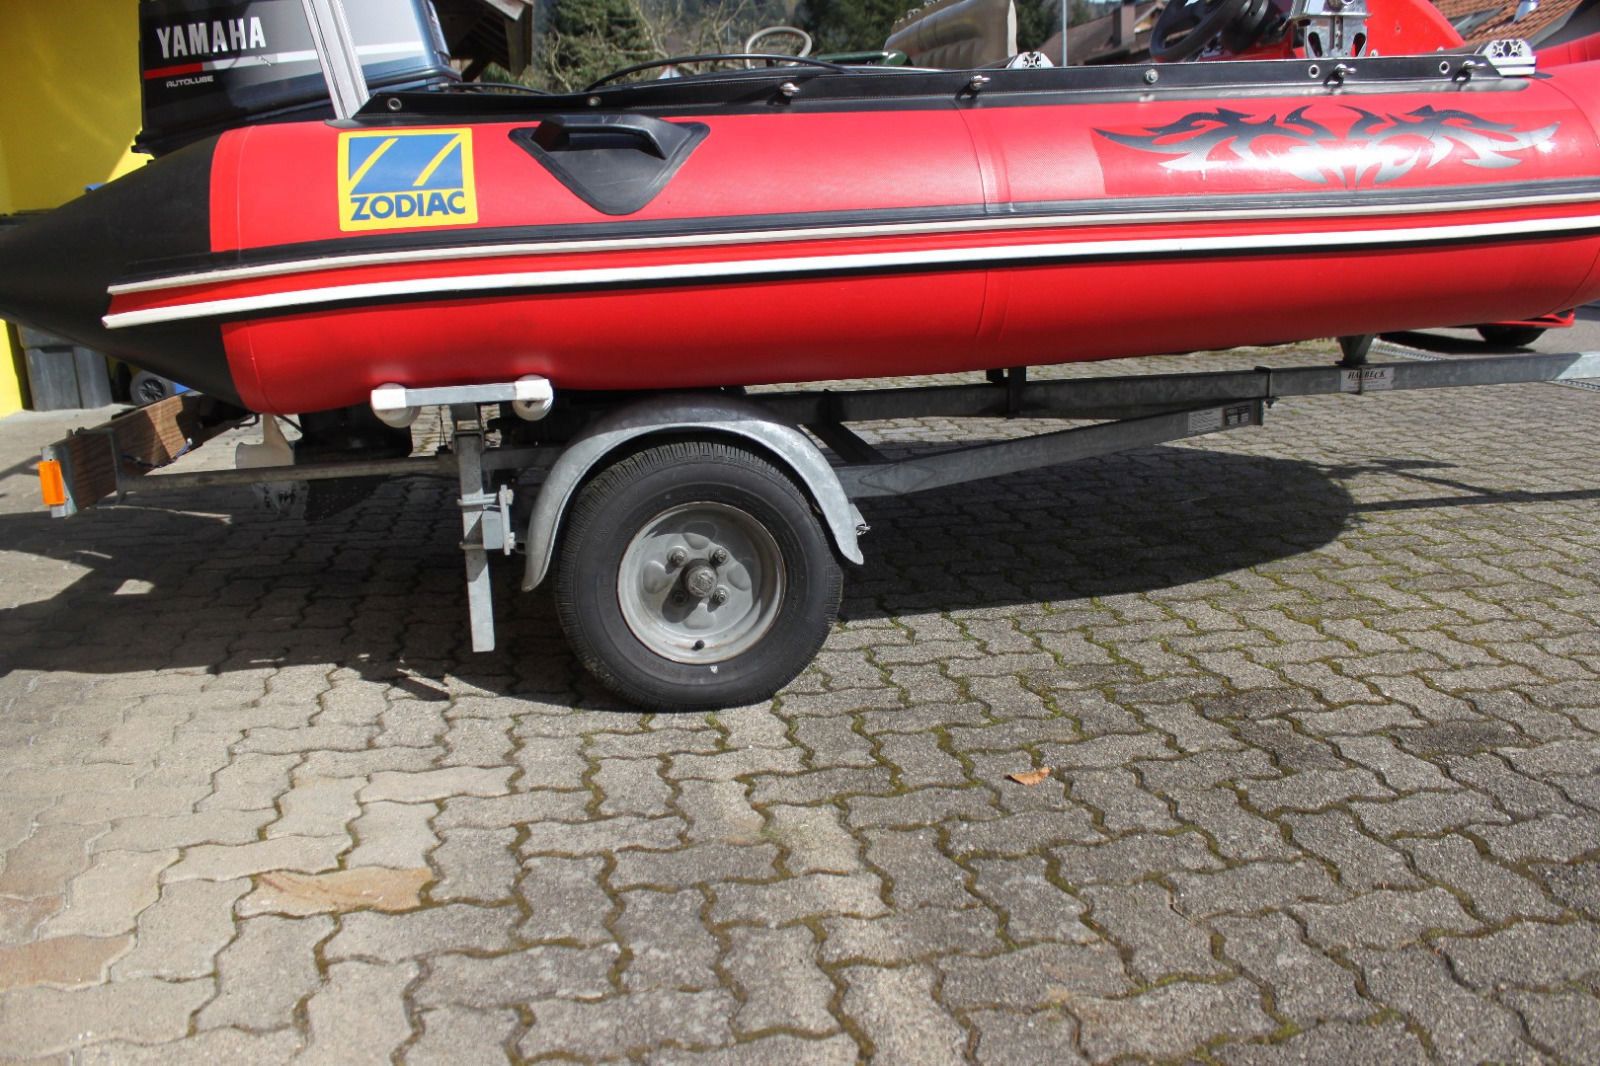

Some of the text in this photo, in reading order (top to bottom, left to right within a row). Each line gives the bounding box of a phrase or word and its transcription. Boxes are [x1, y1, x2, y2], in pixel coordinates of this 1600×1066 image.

[156, 16, 266, 59] YAMAHA
[166, 75, 214, 88] AUTOLUBE
[350, 190, 466, 221] ZODIAC
